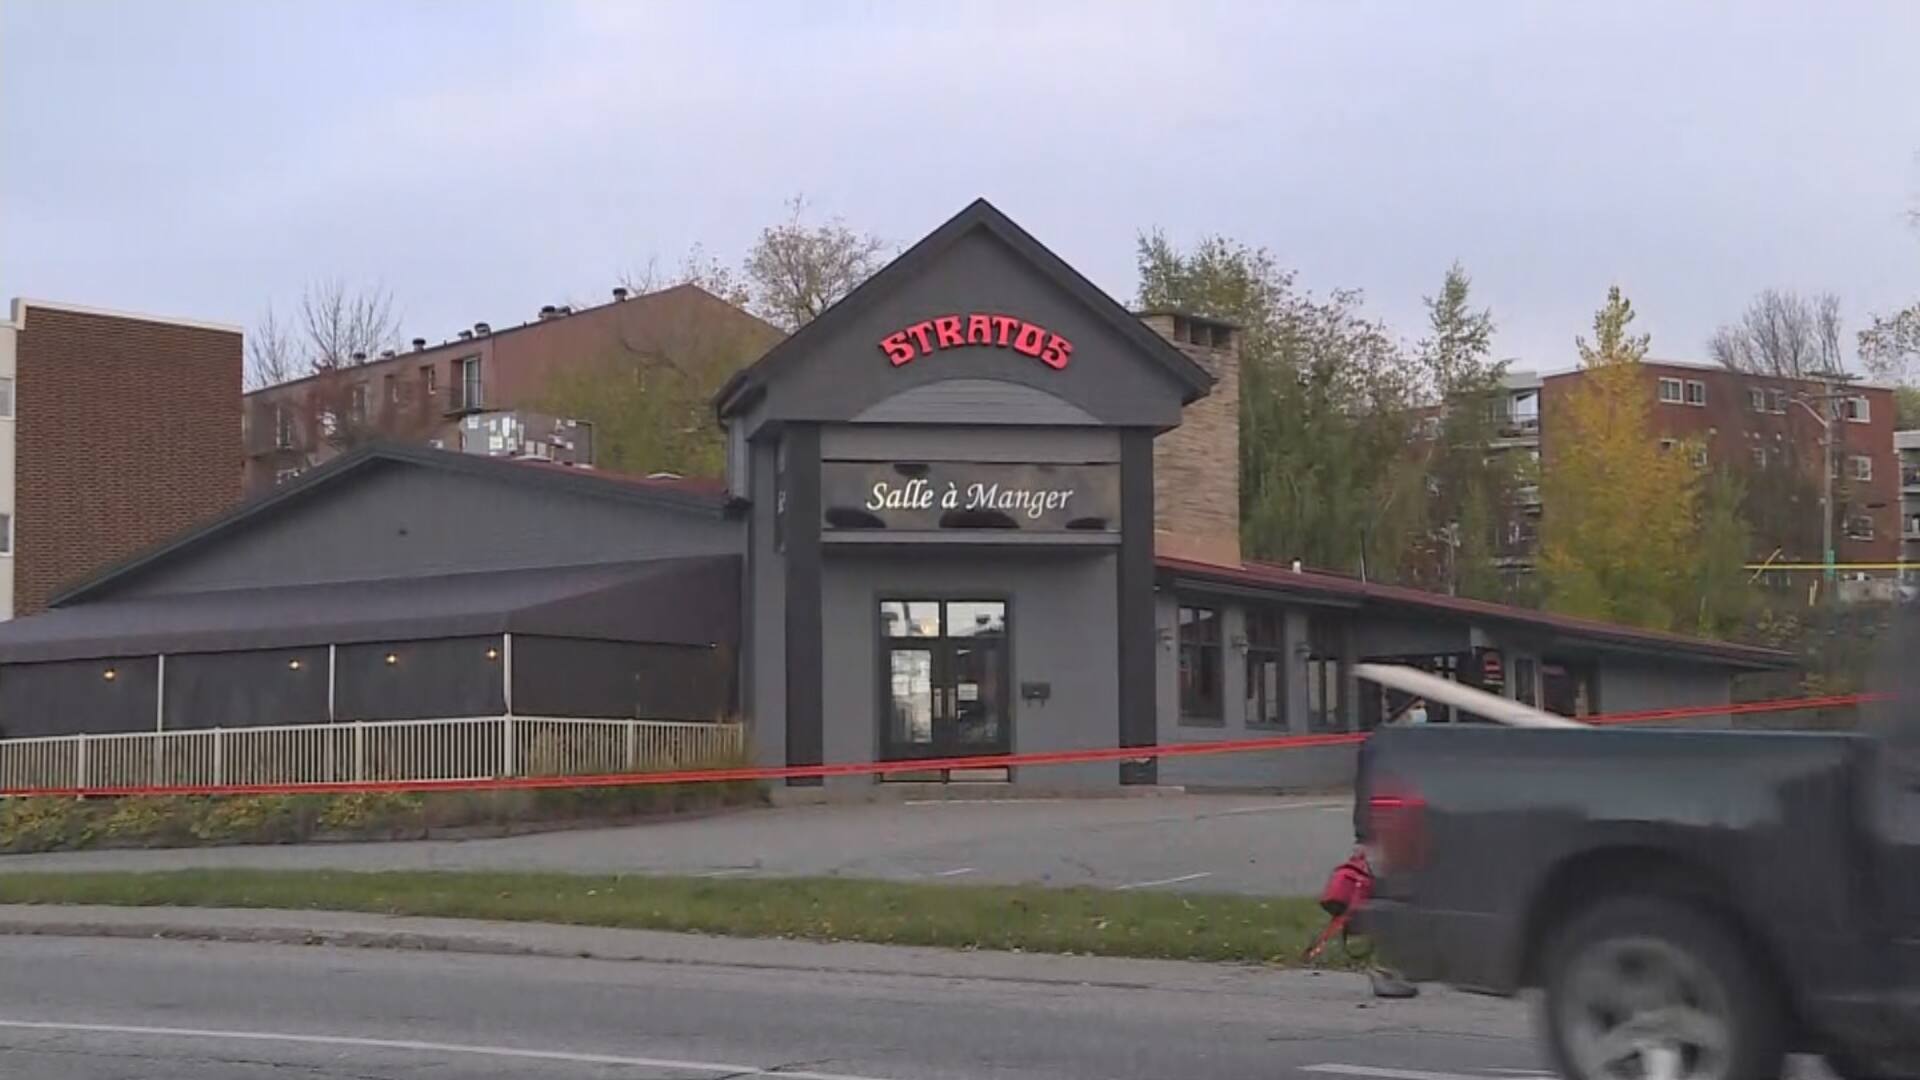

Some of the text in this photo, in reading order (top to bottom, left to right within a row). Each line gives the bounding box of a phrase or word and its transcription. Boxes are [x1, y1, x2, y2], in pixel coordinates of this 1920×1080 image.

[880, 313, 1073, 370] STRATOS
[866, 479, 1074, 519] Salle à Manger
